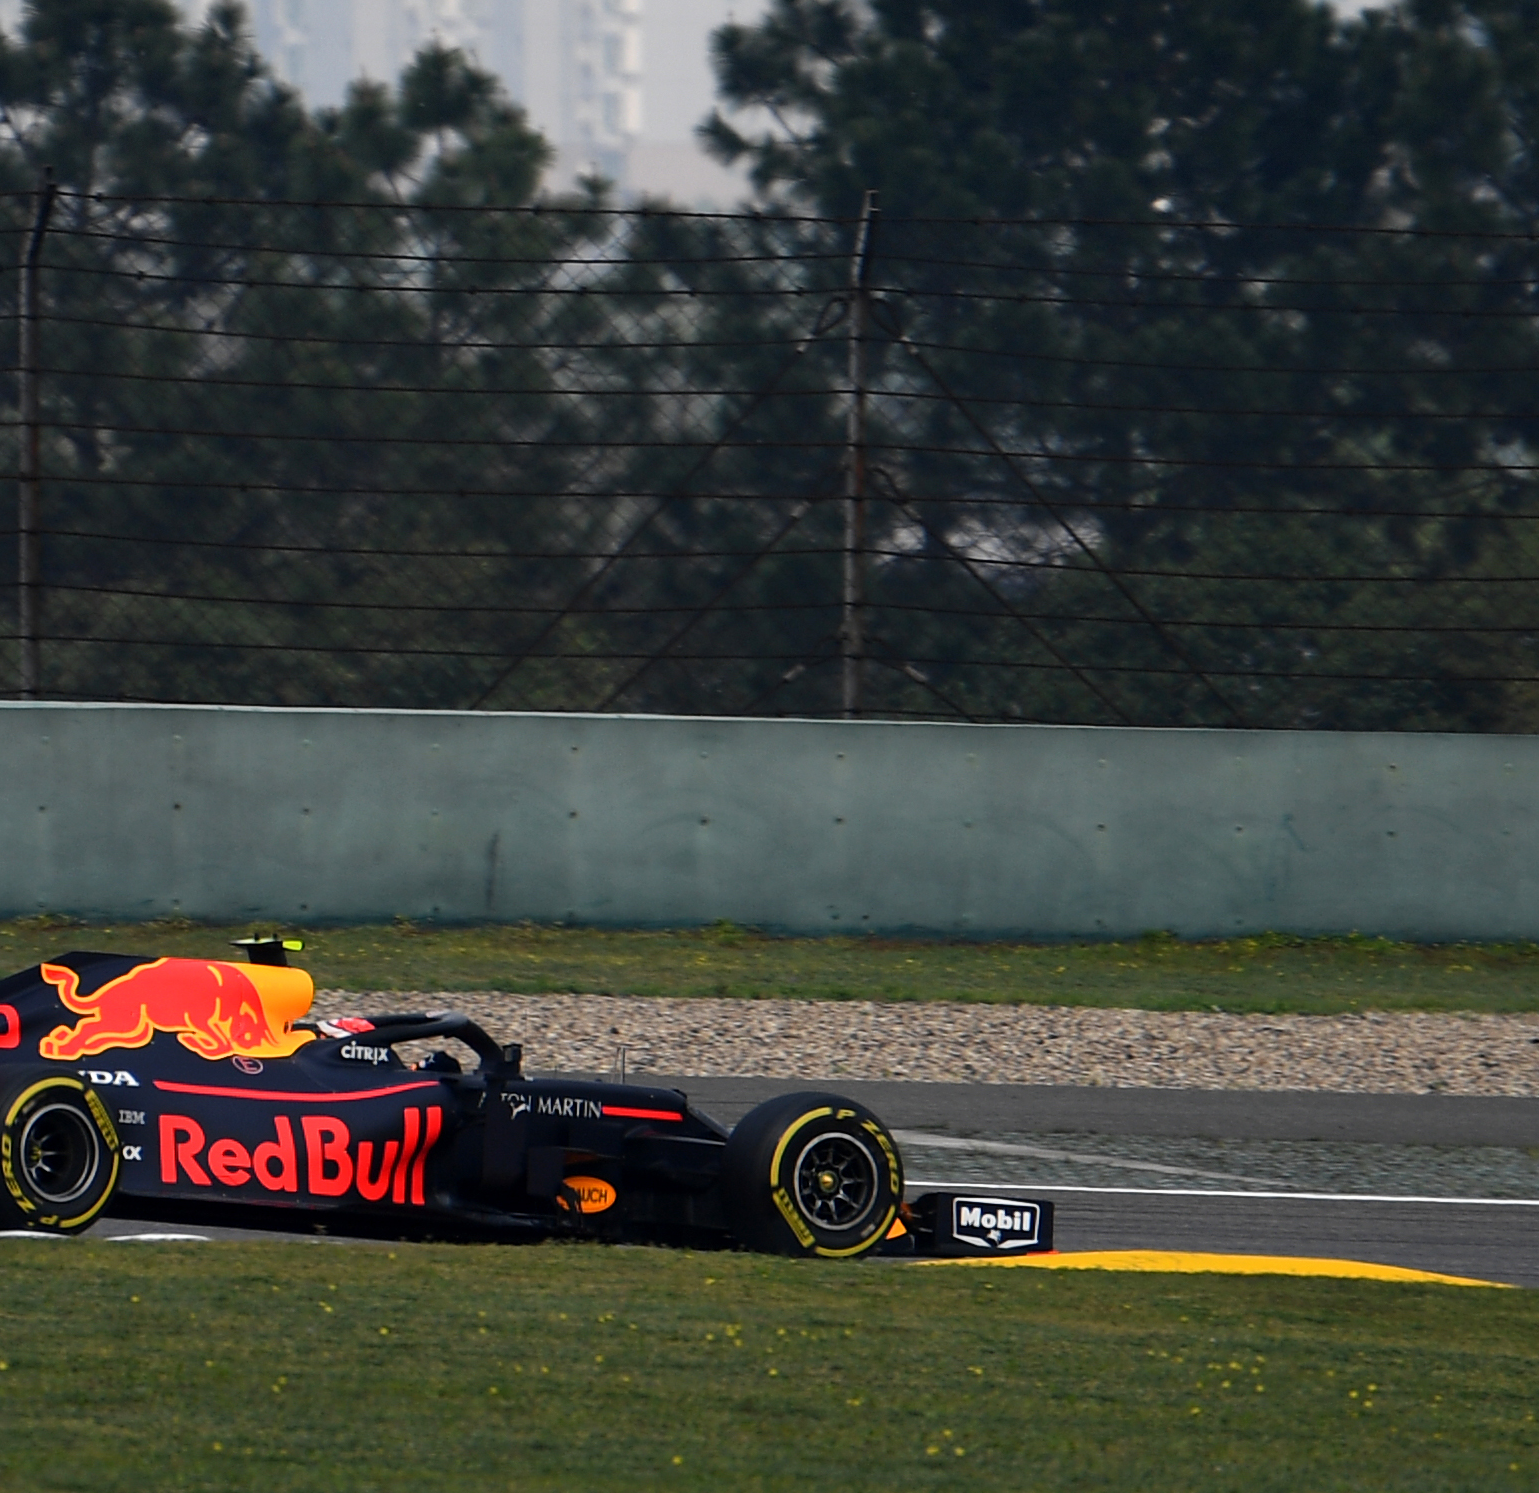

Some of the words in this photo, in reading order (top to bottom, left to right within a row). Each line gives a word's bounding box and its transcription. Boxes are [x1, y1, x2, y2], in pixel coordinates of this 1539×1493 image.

[118, 1109, 146, 1125] IBM
[538, 1096, 602, 1119] MARTIN
[861, 1118, 899, 1195] ZERO
[2, 1133, 37, 1214] ZERO
[960, 1206, 1031, 1232] Mobil
